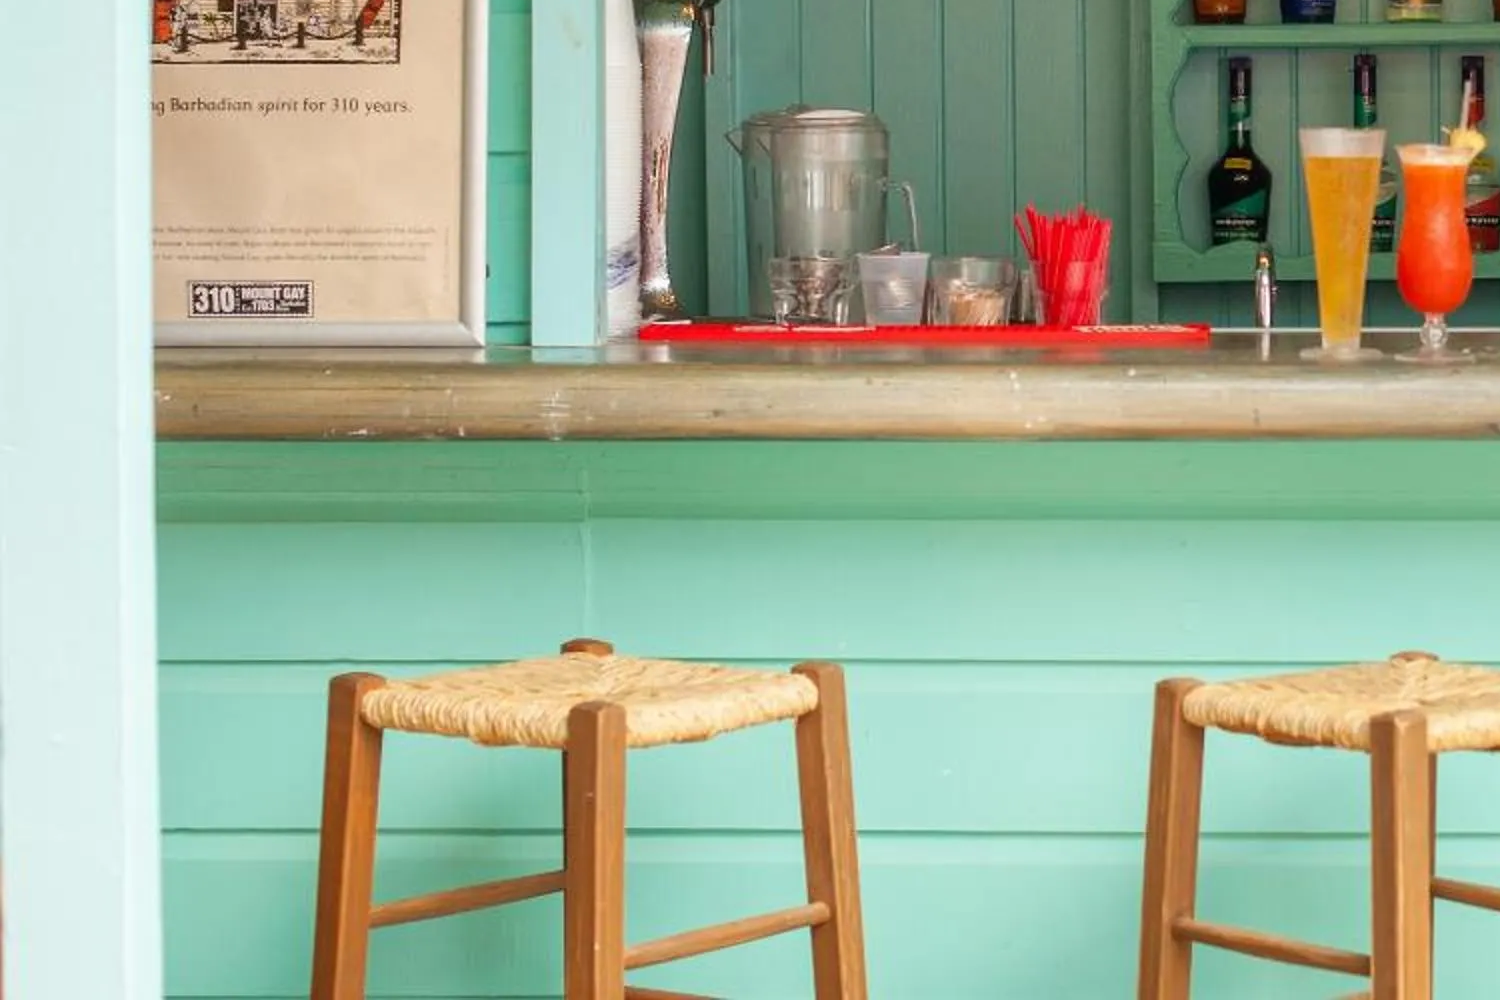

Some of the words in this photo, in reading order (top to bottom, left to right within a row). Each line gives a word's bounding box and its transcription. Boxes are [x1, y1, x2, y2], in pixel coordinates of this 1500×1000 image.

[170, 97, 252, 112] Barbadian
[257, 97, 297, 117] spirit
[302, 96, 325, 112] for
[331, 98, 359, 112] 310
[365, 100, 412, 116] years.
[195, 286, 235, 313] 310
[241, 287, 281, 300] MOUNT
[283, 287, 305, 300] GAY
